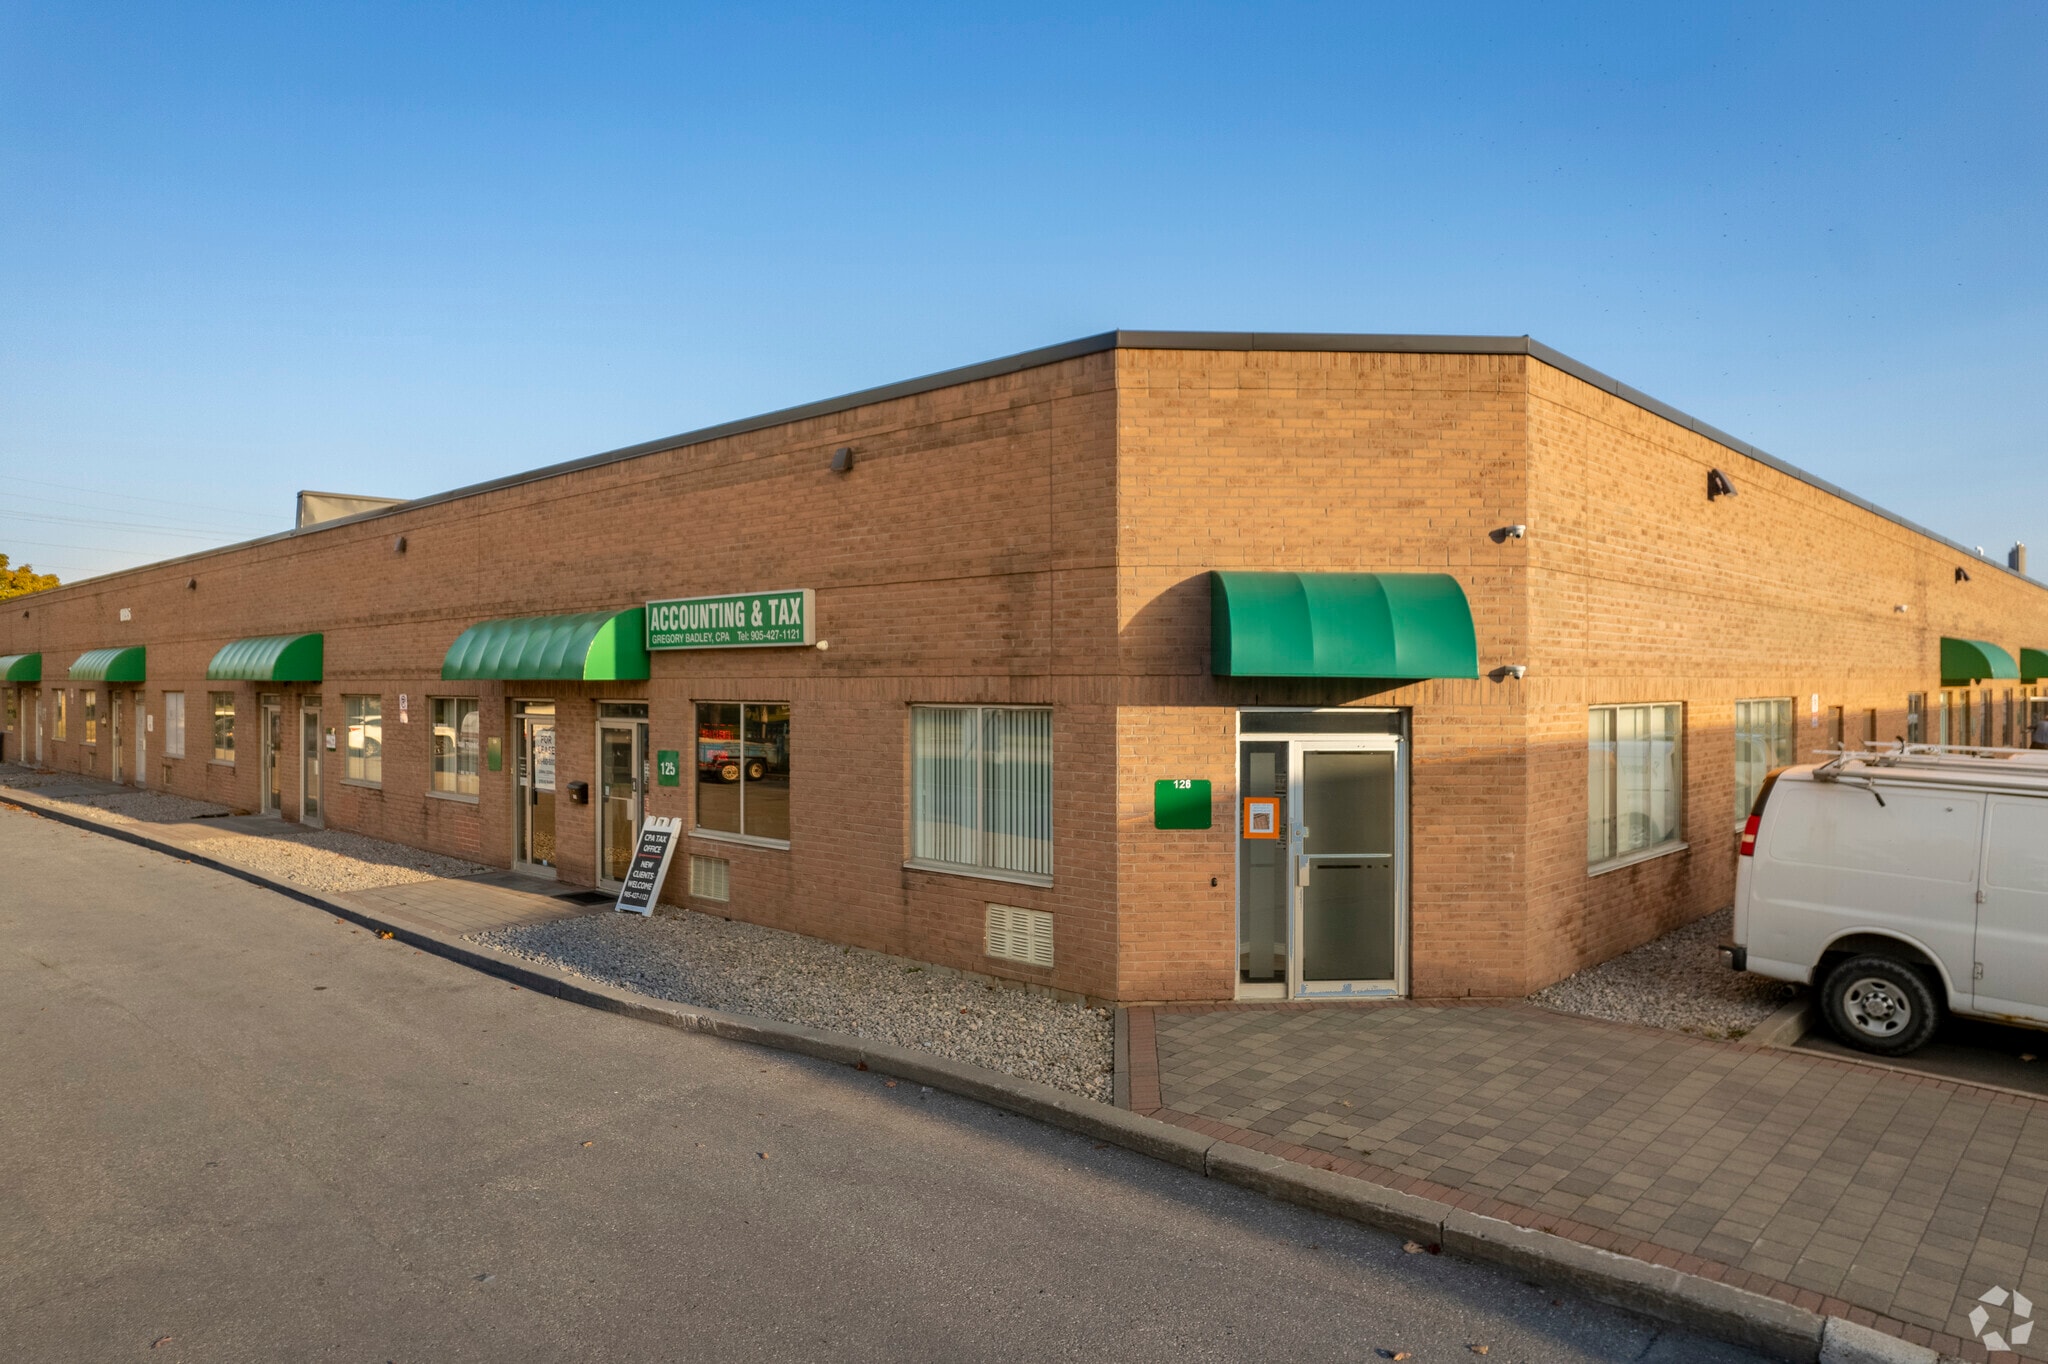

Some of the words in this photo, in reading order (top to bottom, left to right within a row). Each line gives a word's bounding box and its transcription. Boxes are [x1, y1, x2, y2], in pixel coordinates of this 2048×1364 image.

[650, 601, 745, 631] ACCOUNTING
[751, 600, 763, 627] &
[768, 597, 801, 626] TAX
[652, 634, 684, 644] GREGORY
[685, 632, 714, 644] BADLEY,
[715, 632, 730, 643] CPA
[737, 631, 749, 641] Tel:
[750, 629, 800, 641] 905-427-1121
[660, 762, 675, 775] 125
[644, 834, 655, 842] CPA
[656, 835, 667, 843] TAX
[643, 845, 662, 853] OFFICE
[633, 871, 654, 879] CLIENTS
[628, 881, 653, 890] WELCOME
